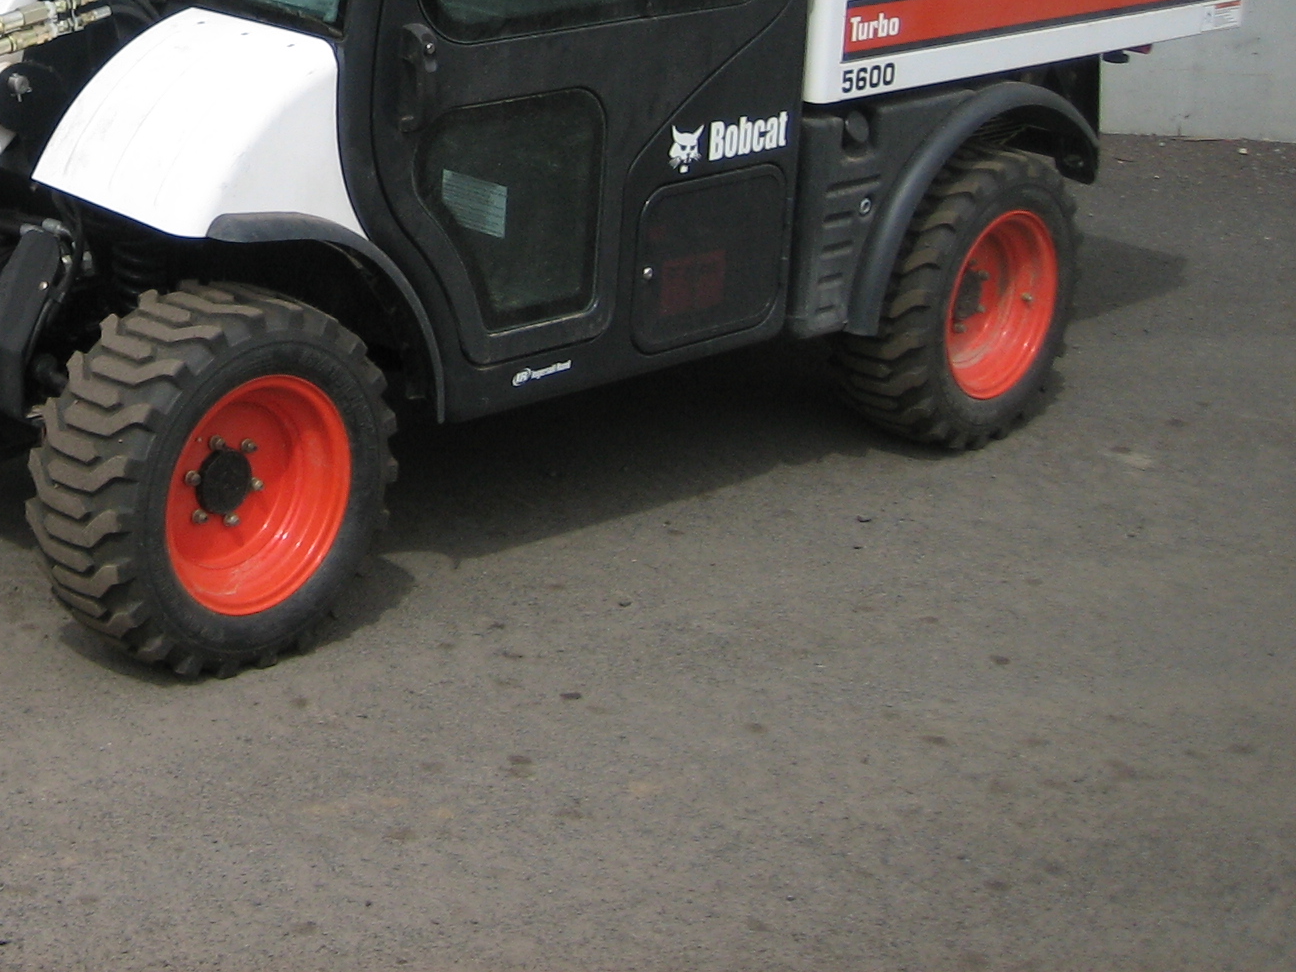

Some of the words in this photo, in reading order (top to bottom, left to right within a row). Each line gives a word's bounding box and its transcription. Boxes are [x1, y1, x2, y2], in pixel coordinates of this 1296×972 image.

[850, 13, 899, 42] Turbo
[842, 63, 895, 93] 5600
[709, 111, 788, 161] Bobcat
